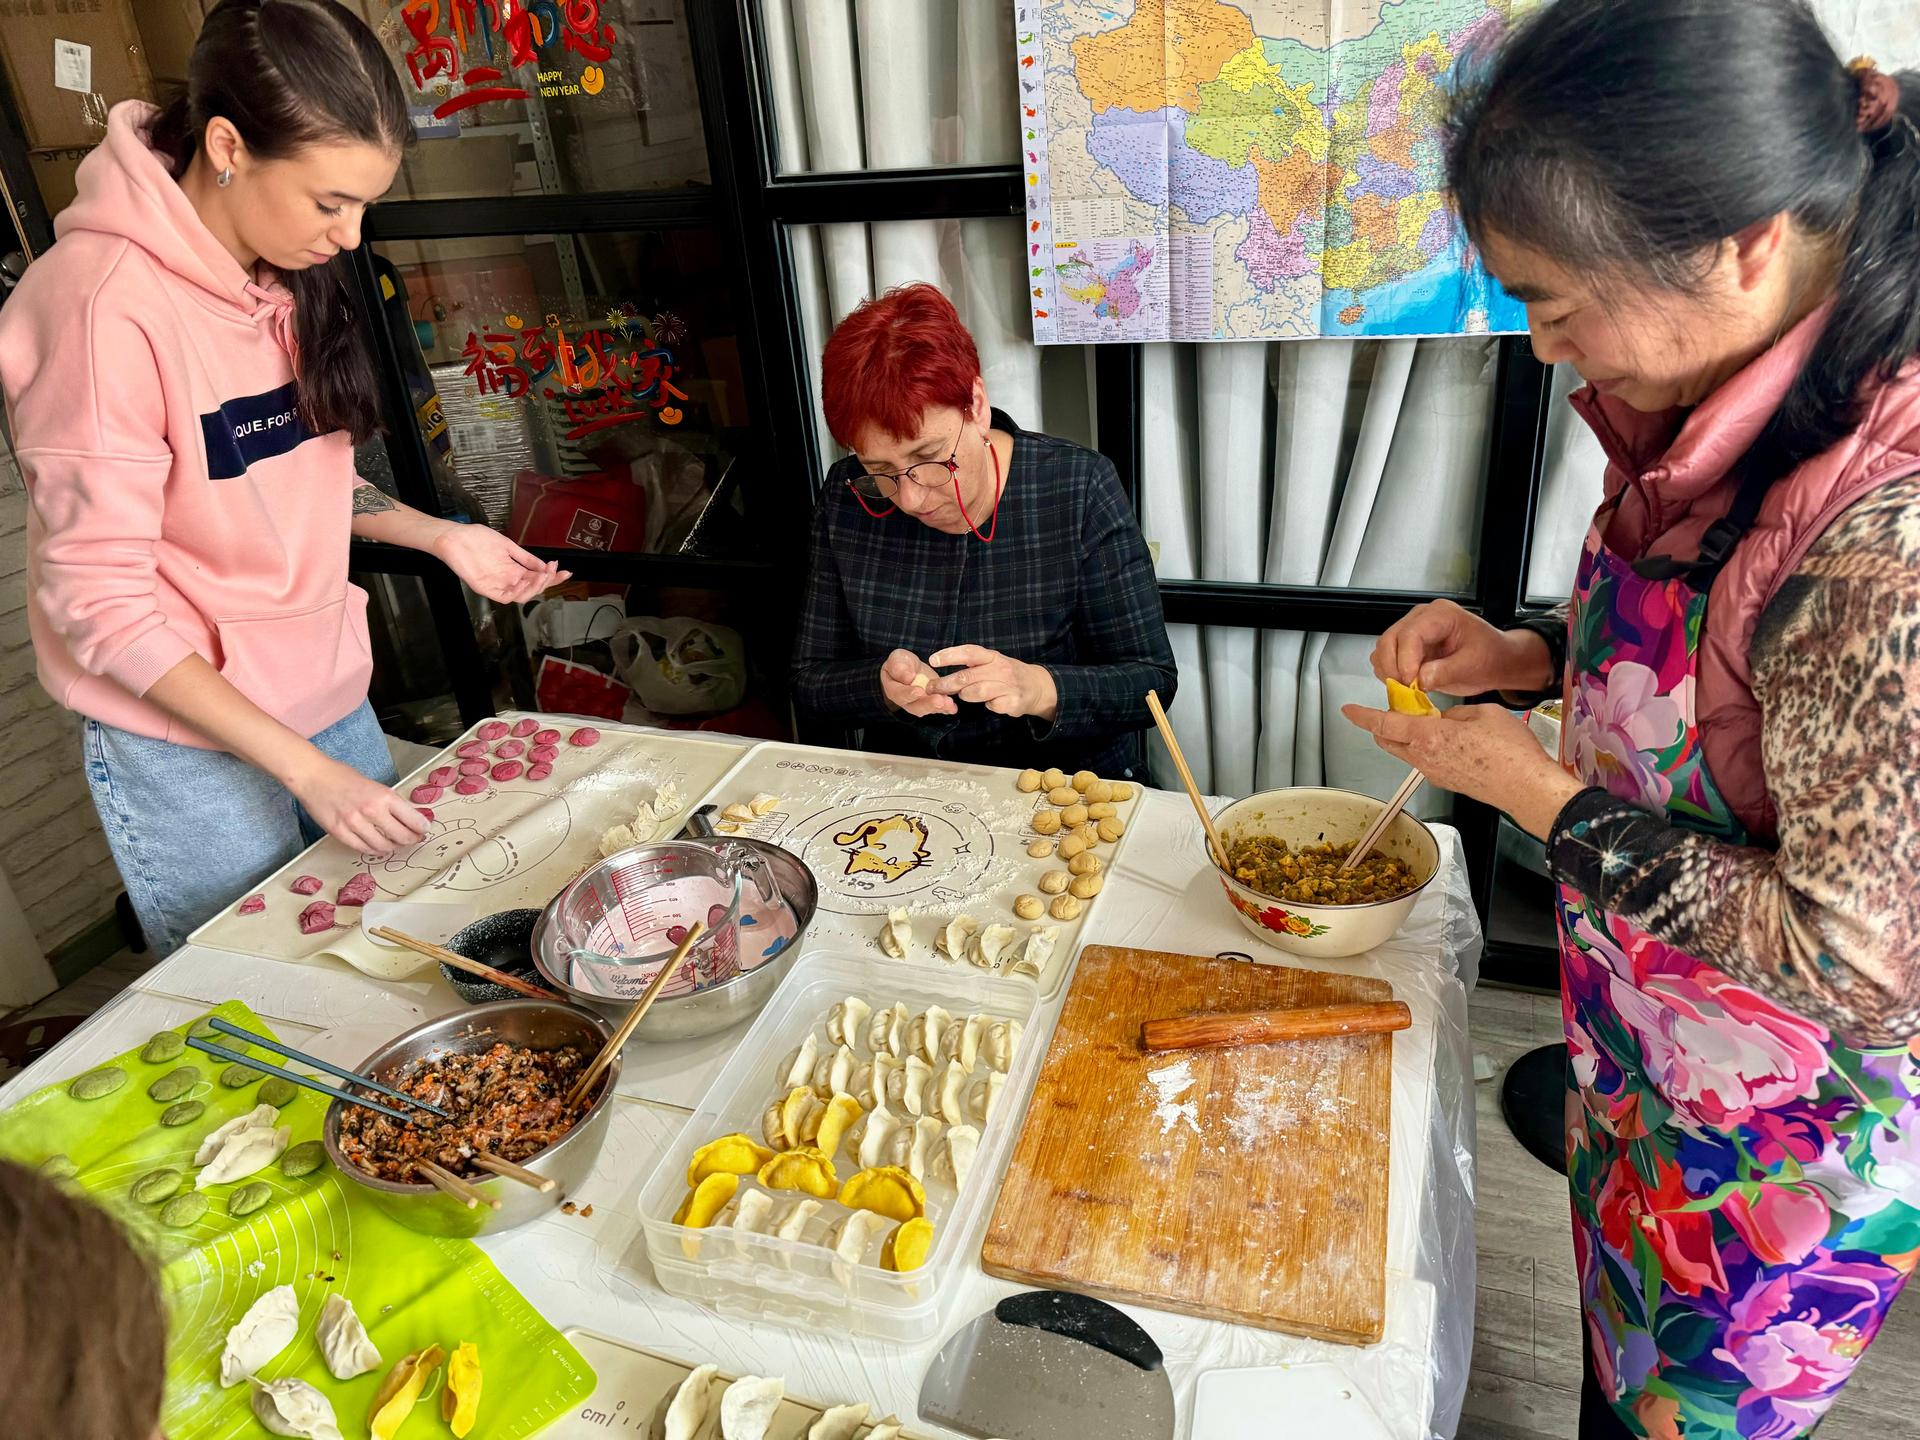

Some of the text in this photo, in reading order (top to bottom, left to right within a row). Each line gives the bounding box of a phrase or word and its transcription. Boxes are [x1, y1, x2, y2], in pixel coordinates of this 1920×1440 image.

[536, 70, 562, 83] HAPPY
[540, 84, 580, 97] NEW YEAR
[616, 1400, 626, 1411] 0
[580, 1407, 607, 1425] cm
